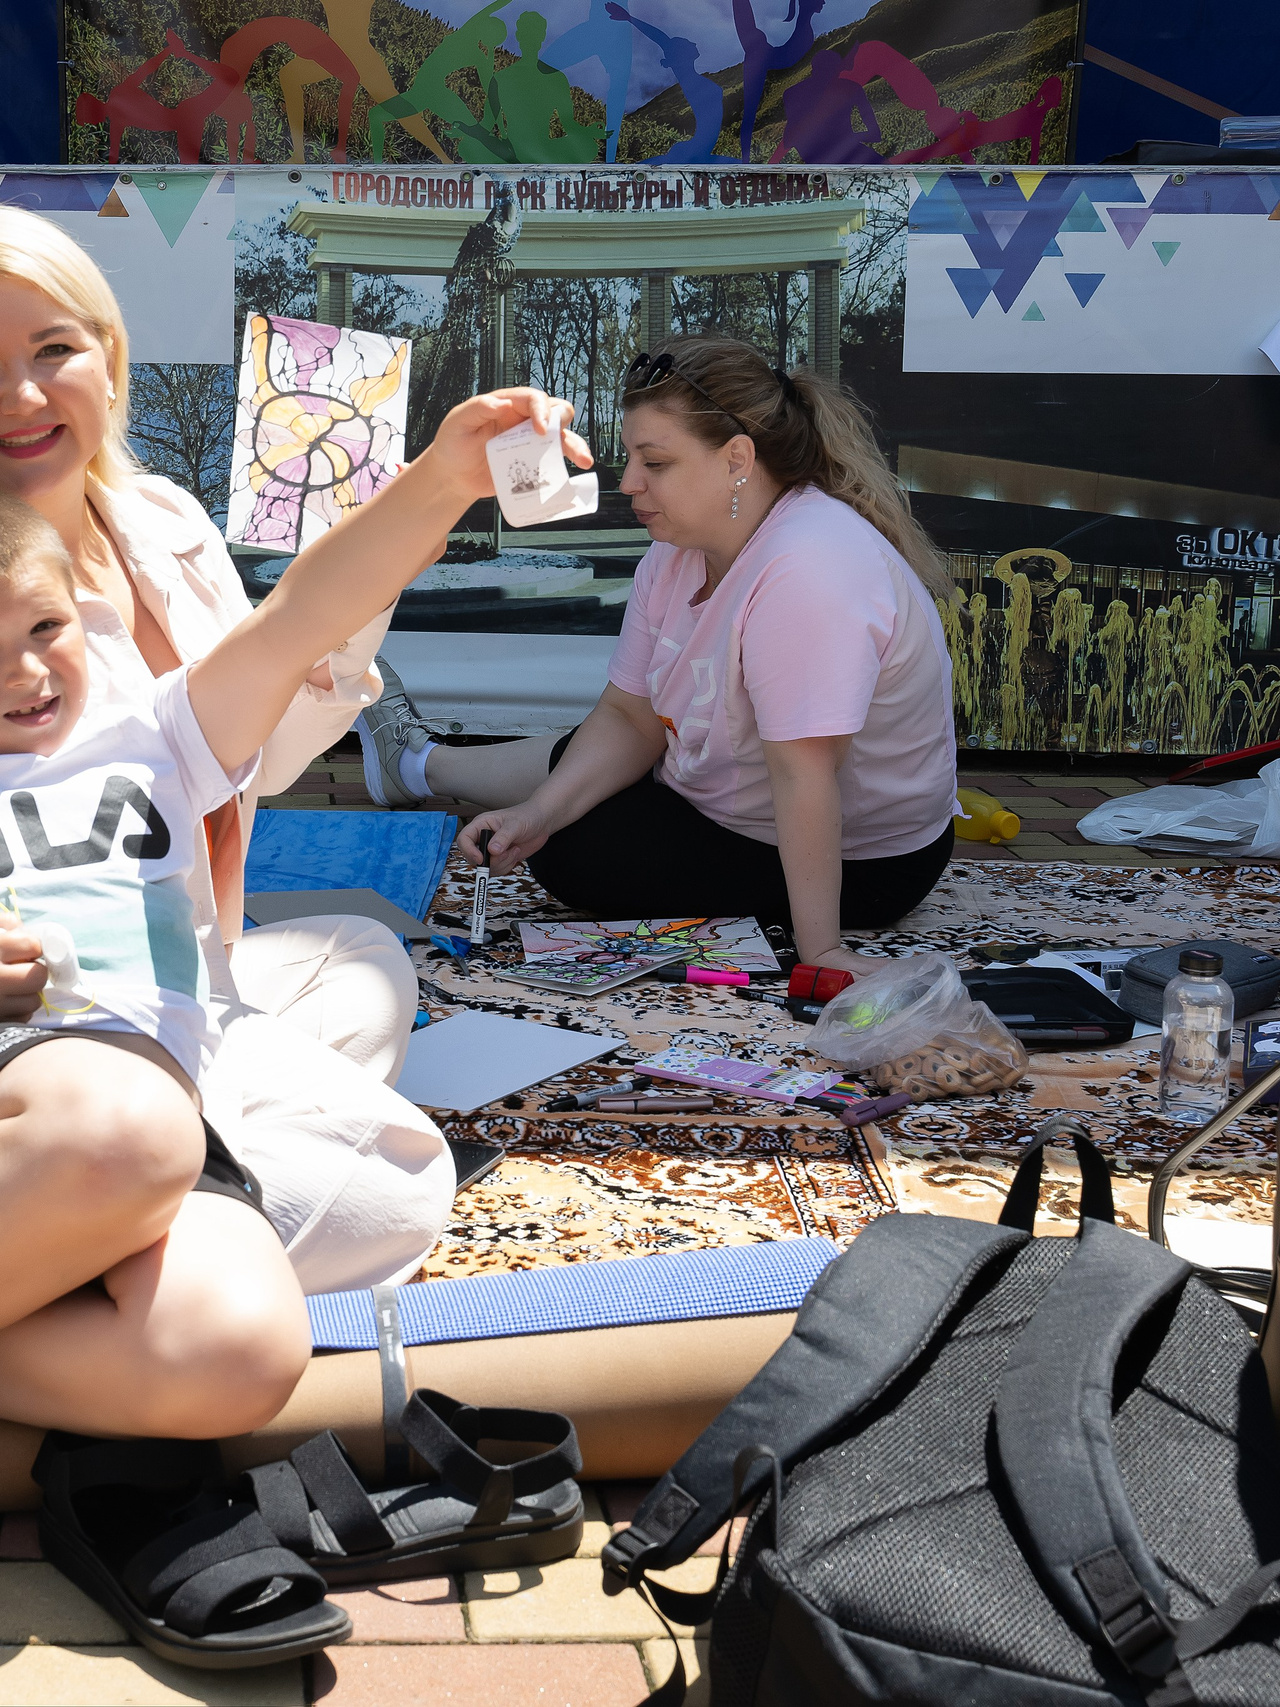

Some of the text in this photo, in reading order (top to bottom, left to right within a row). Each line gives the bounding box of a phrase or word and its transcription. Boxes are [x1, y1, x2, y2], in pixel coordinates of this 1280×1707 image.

[332, 171, 474, 209] ГОРОДСКОЙ
[555, 178, 683, 211] КУЛЬТУРЫ
[694, 172, 709, 207] И
[720, 173, 830, 207] ОТДЫХА
[1217, 528, 1280, 558] ОКТ
[476, 878, 486, 915] WHITEBOARD
